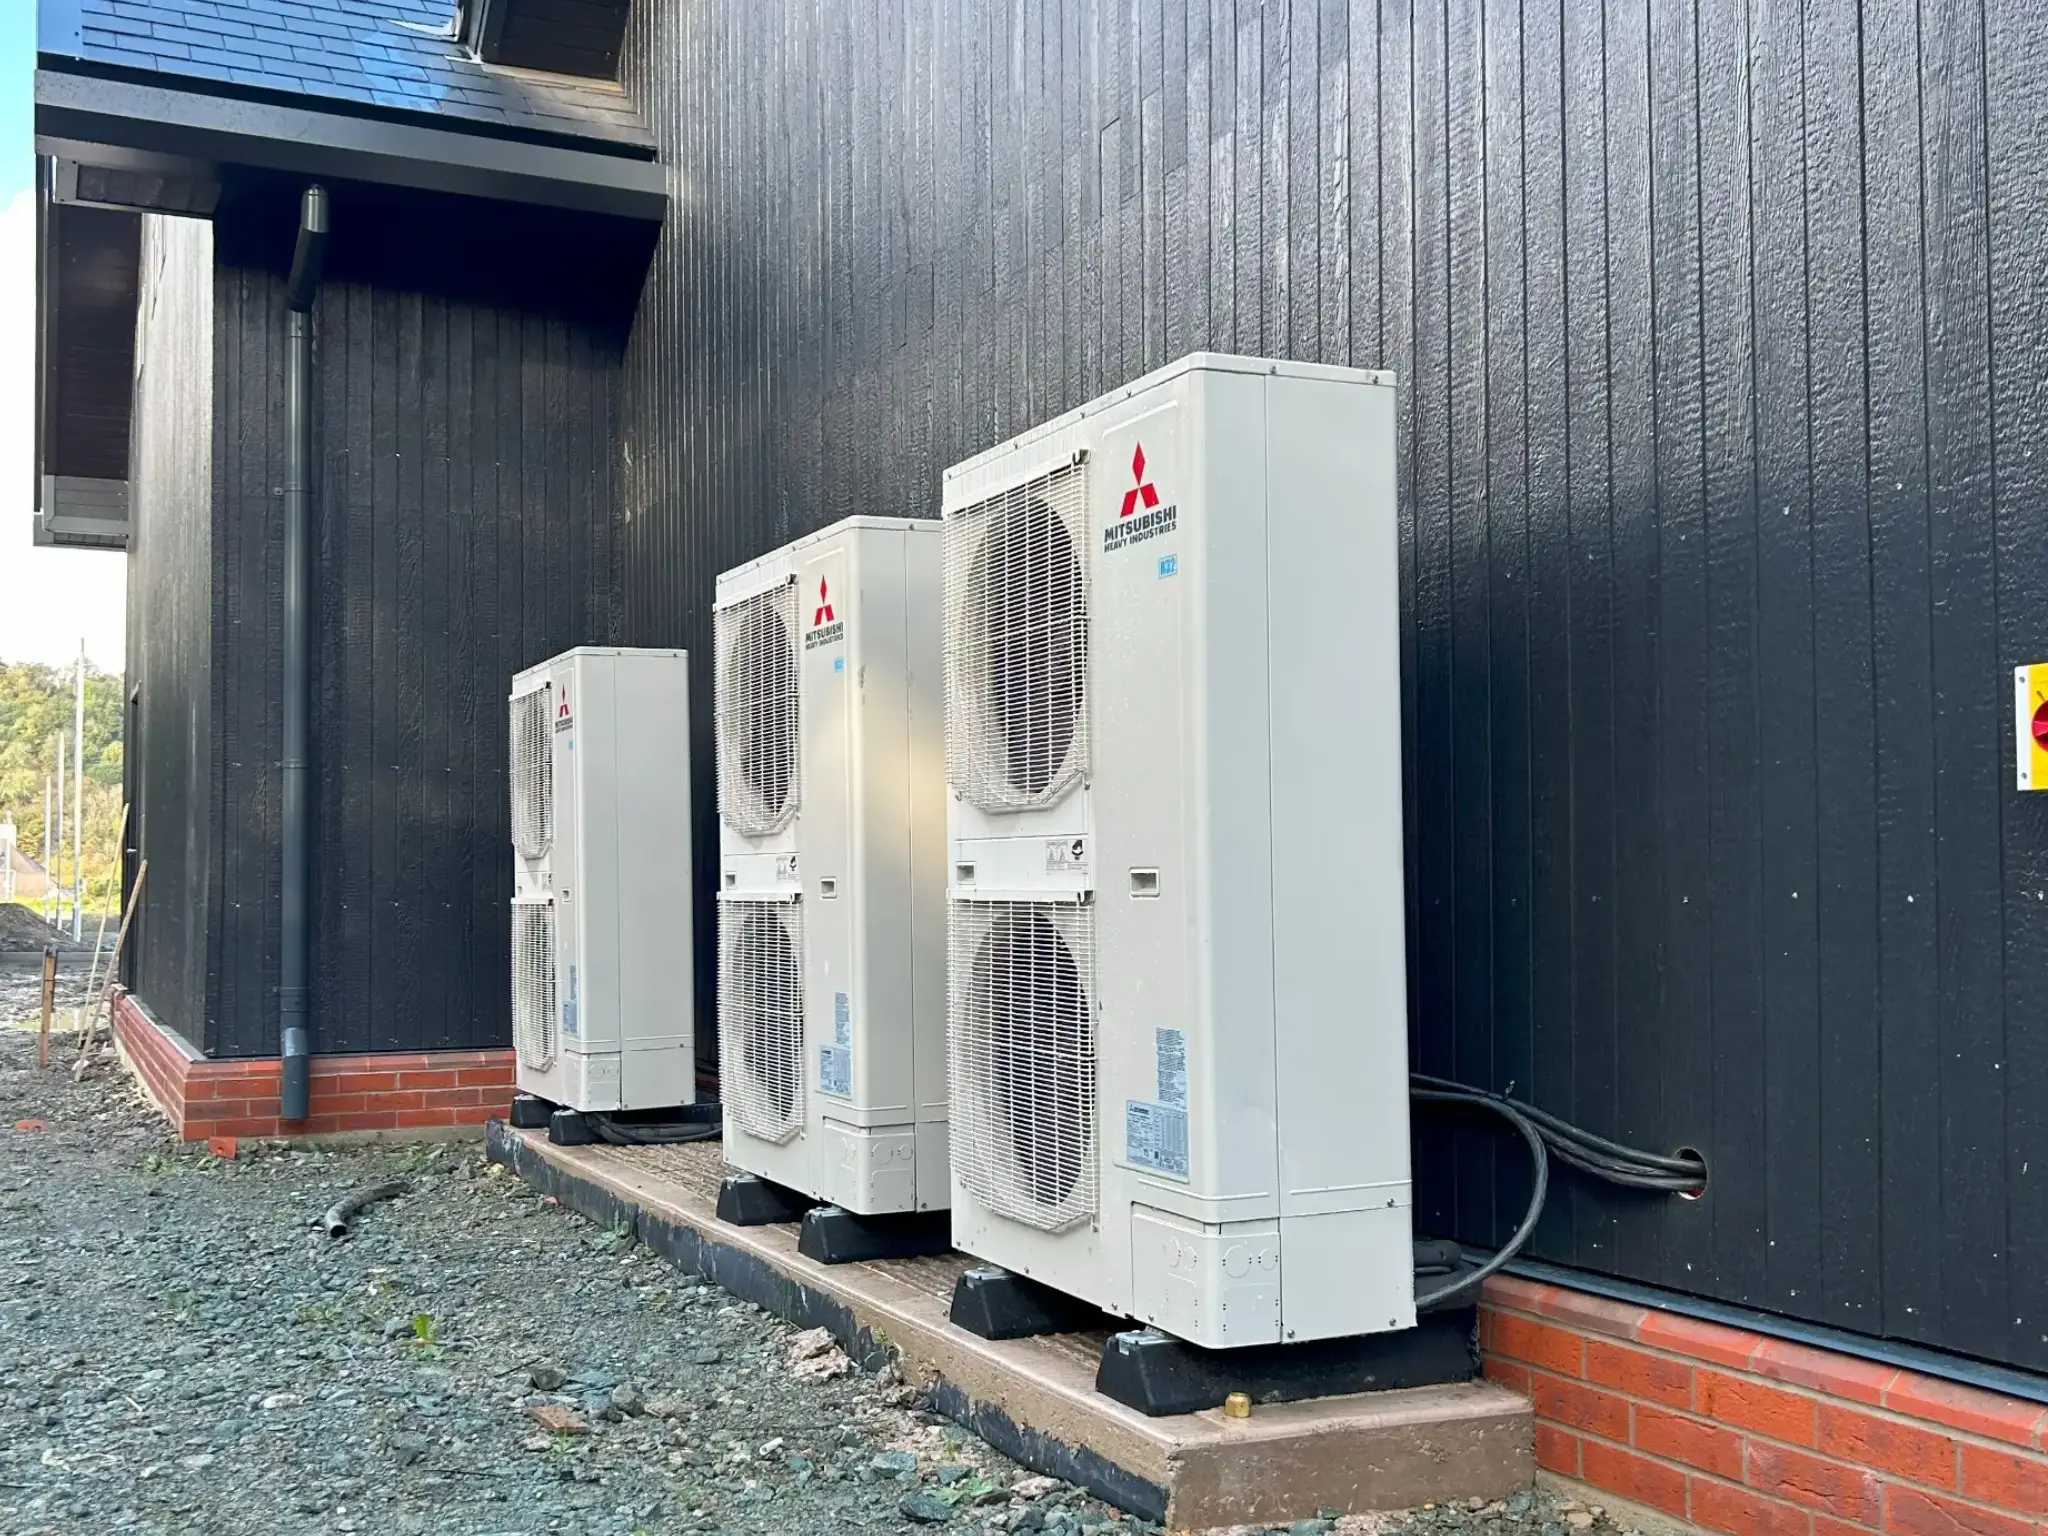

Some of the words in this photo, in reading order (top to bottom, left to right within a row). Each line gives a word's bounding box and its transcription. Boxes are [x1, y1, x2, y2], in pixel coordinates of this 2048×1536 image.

[1104, 505, 1177, 543] MITSUBISHI
[1104, 537, 1127, 553] HEAVY
[1130, 521, 1177, 544] INDUSTRIES
